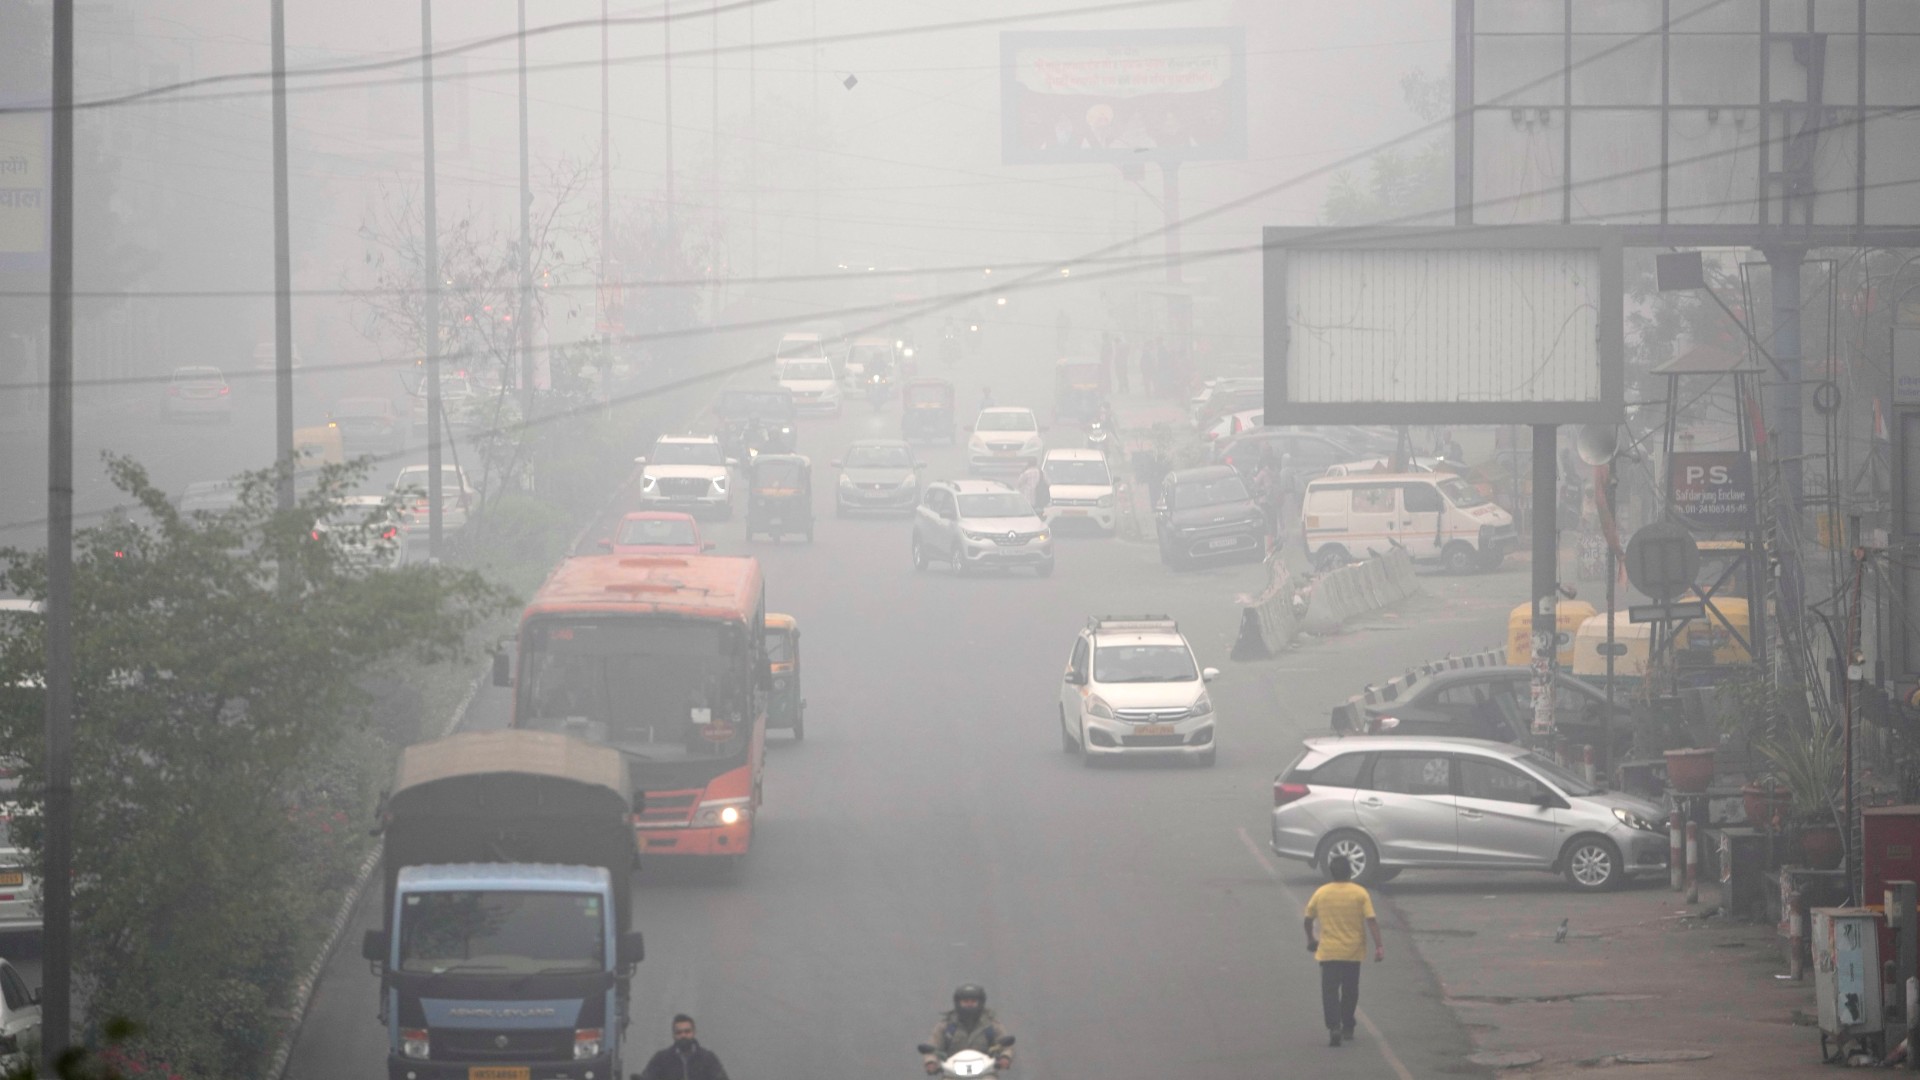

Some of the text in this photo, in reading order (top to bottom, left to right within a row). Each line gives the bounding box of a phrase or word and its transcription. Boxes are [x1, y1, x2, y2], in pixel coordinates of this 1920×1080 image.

[1675, 489, 1746, 503] Safdarjung Enclave
[496, 1007, 555, 1017] LEYLAND
